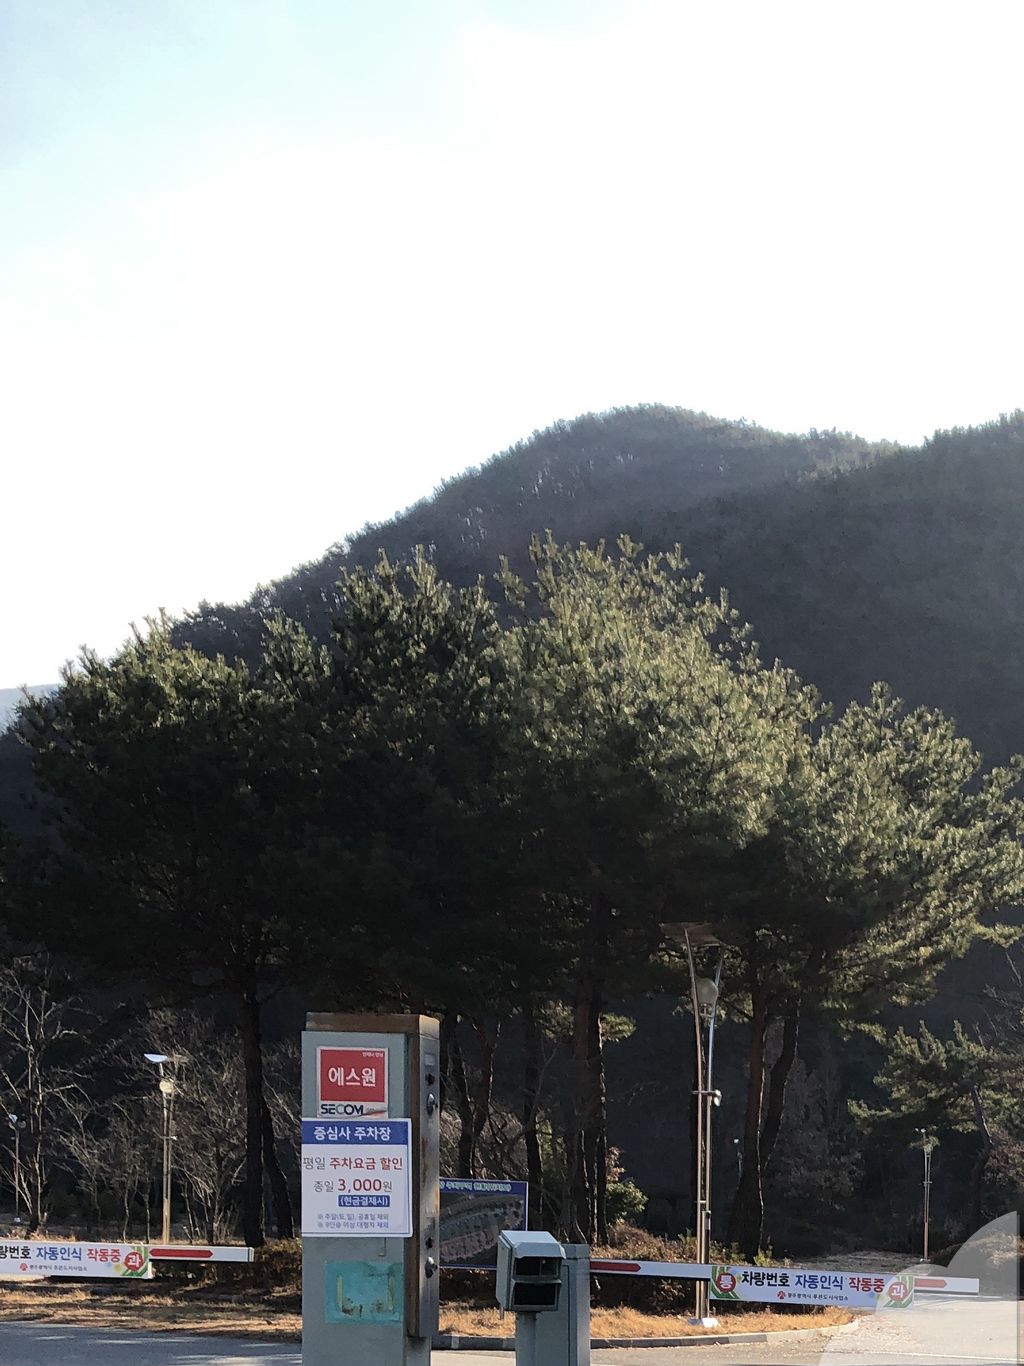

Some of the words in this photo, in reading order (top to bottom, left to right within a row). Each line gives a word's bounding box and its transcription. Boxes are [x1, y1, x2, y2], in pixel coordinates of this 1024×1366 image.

[328, 1067, 376, 1087] 에스원
[320, 1103, 364, 1116] SECOM
[313, 1126, 350, 1140] 증심사
[354, 1126, 391, 1141] 주차장
[303, 1156, 326, 1170] 평일
[329, 1157, 377, 1170] 주차요금
[380, 1157, 403, 1170] 할인
[313, 1180, 334, 1193] 종일
[337, 1178, 393, 1193] 3,000원
[36, 1246, 82, 1261] 자동인식
[87, 1248, 121, 1262] 작동중
[127, 1254, 142, 1268] 과
[741, 1271, 790, 1287] 차량번호
[795, 1274, 844, 1290] 자동인식
[848, 1276, 885, 1293] 작동중
[890, 1283, 906, 1298] 과
